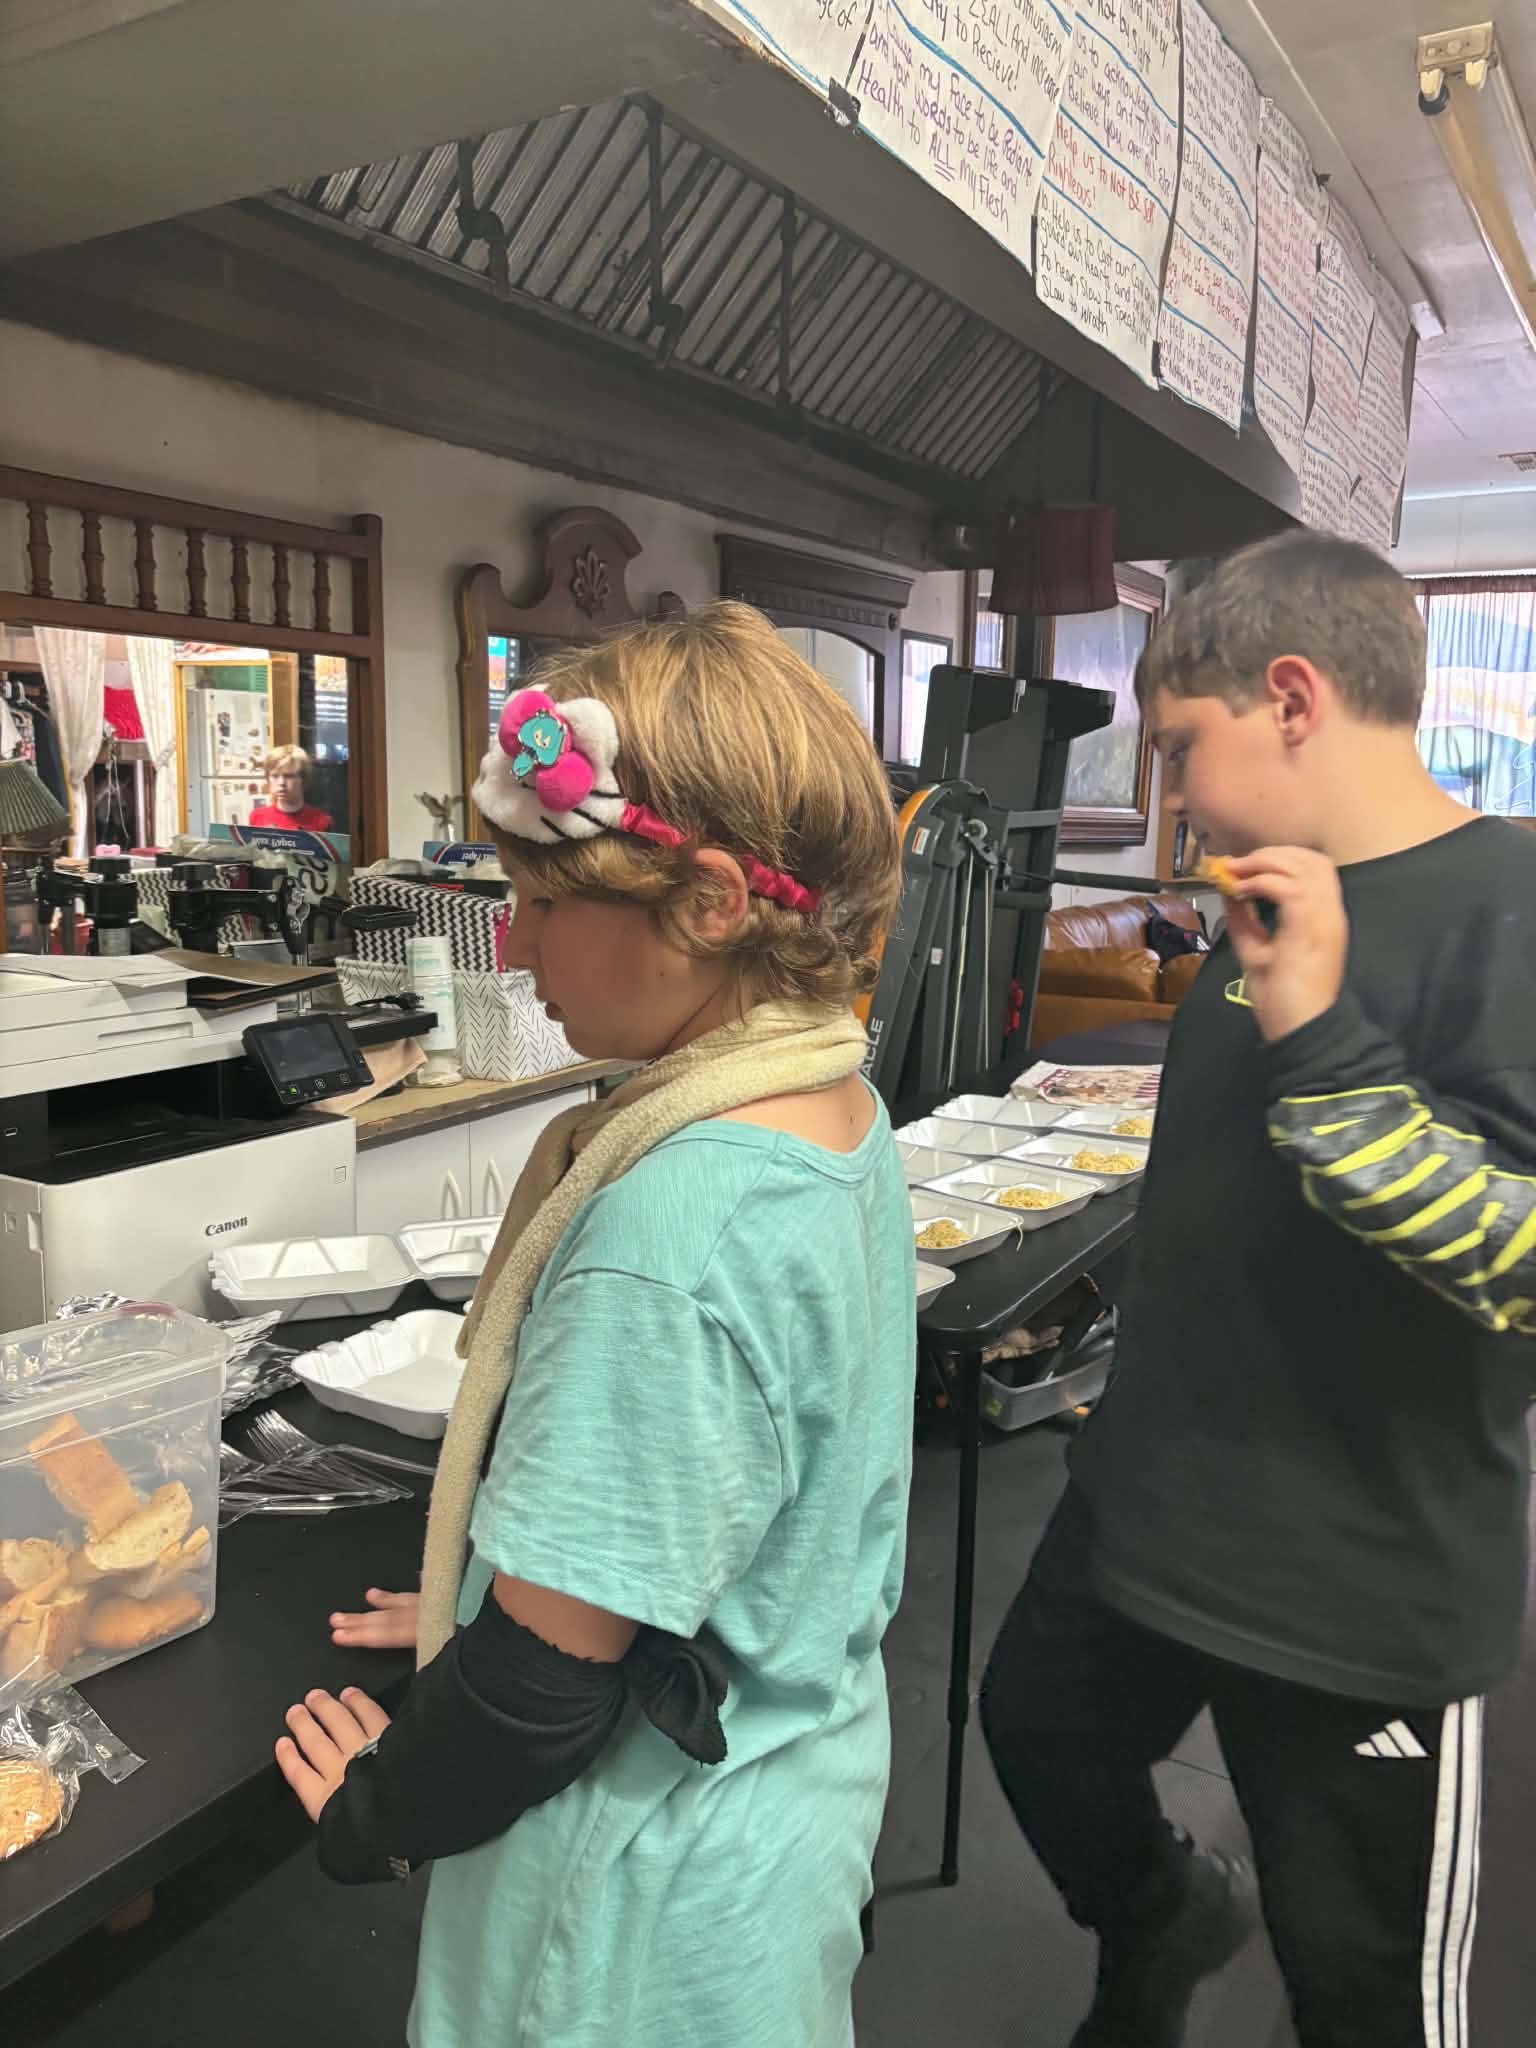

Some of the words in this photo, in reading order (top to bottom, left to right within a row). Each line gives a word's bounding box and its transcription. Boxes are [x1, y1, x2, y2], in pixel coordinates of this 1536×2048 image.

[954, 5, 968, 42] to
[1089, 40, 1099, 69] to
[919, 62, 941, 101] my
[975, 95, 985, 134] to
[988, 111, 999, 146] be
[857, 59, 904, 128] Health
[907, 109, 921, 145] to
[979, 174, 1009, 232] Flesh
[953, 116, 965, 145] to
[968, 132, 980, 159] be
[1056, 114, 1078, 166] Help
[1085, 224, 1096, 253] to
[204, 1216, 249, 1237] Canon
